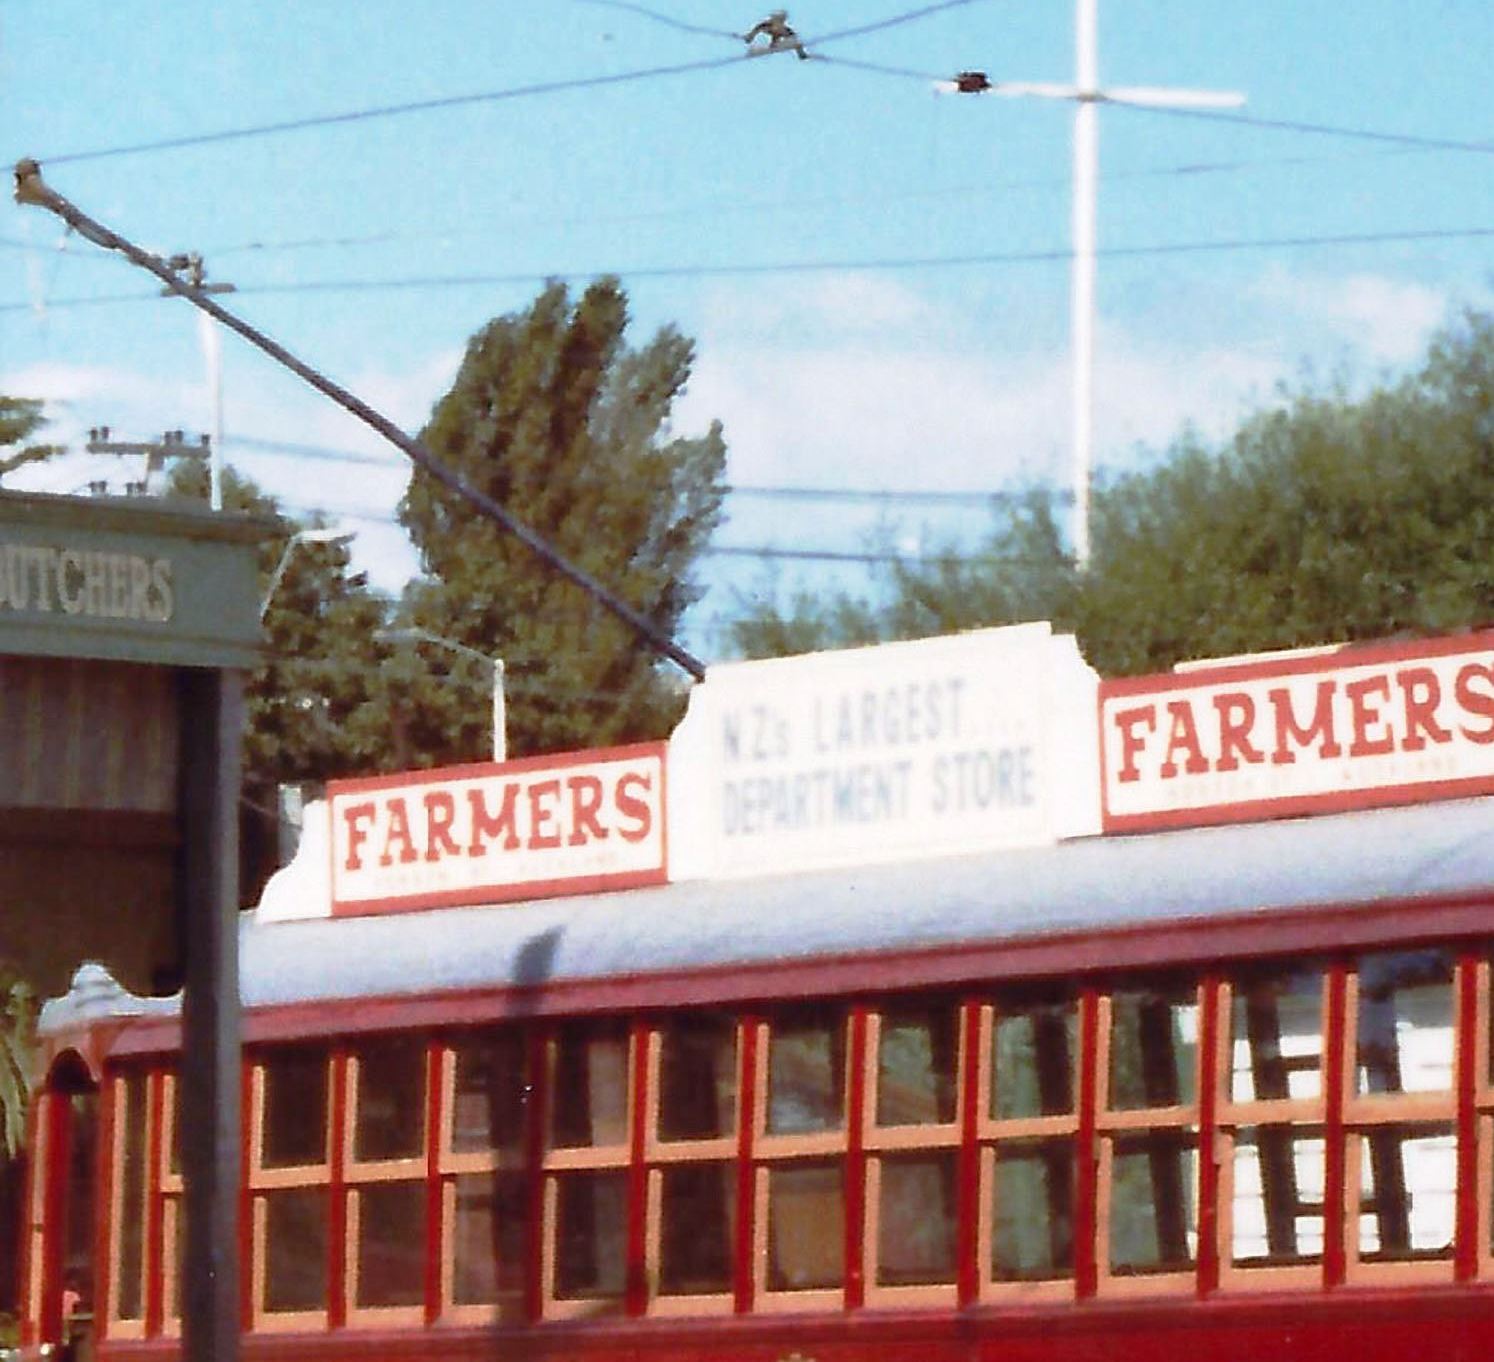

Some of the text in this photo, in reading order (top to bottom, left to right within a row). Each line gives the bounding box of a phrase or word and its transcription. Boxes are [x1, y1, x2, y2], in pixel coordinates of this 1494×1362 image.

[812, 677, 967, 754] LARGEST
[343, 769, 655, 873] FARMERS
[722, 744, 1037, 837] DEPARTMENT STORE
